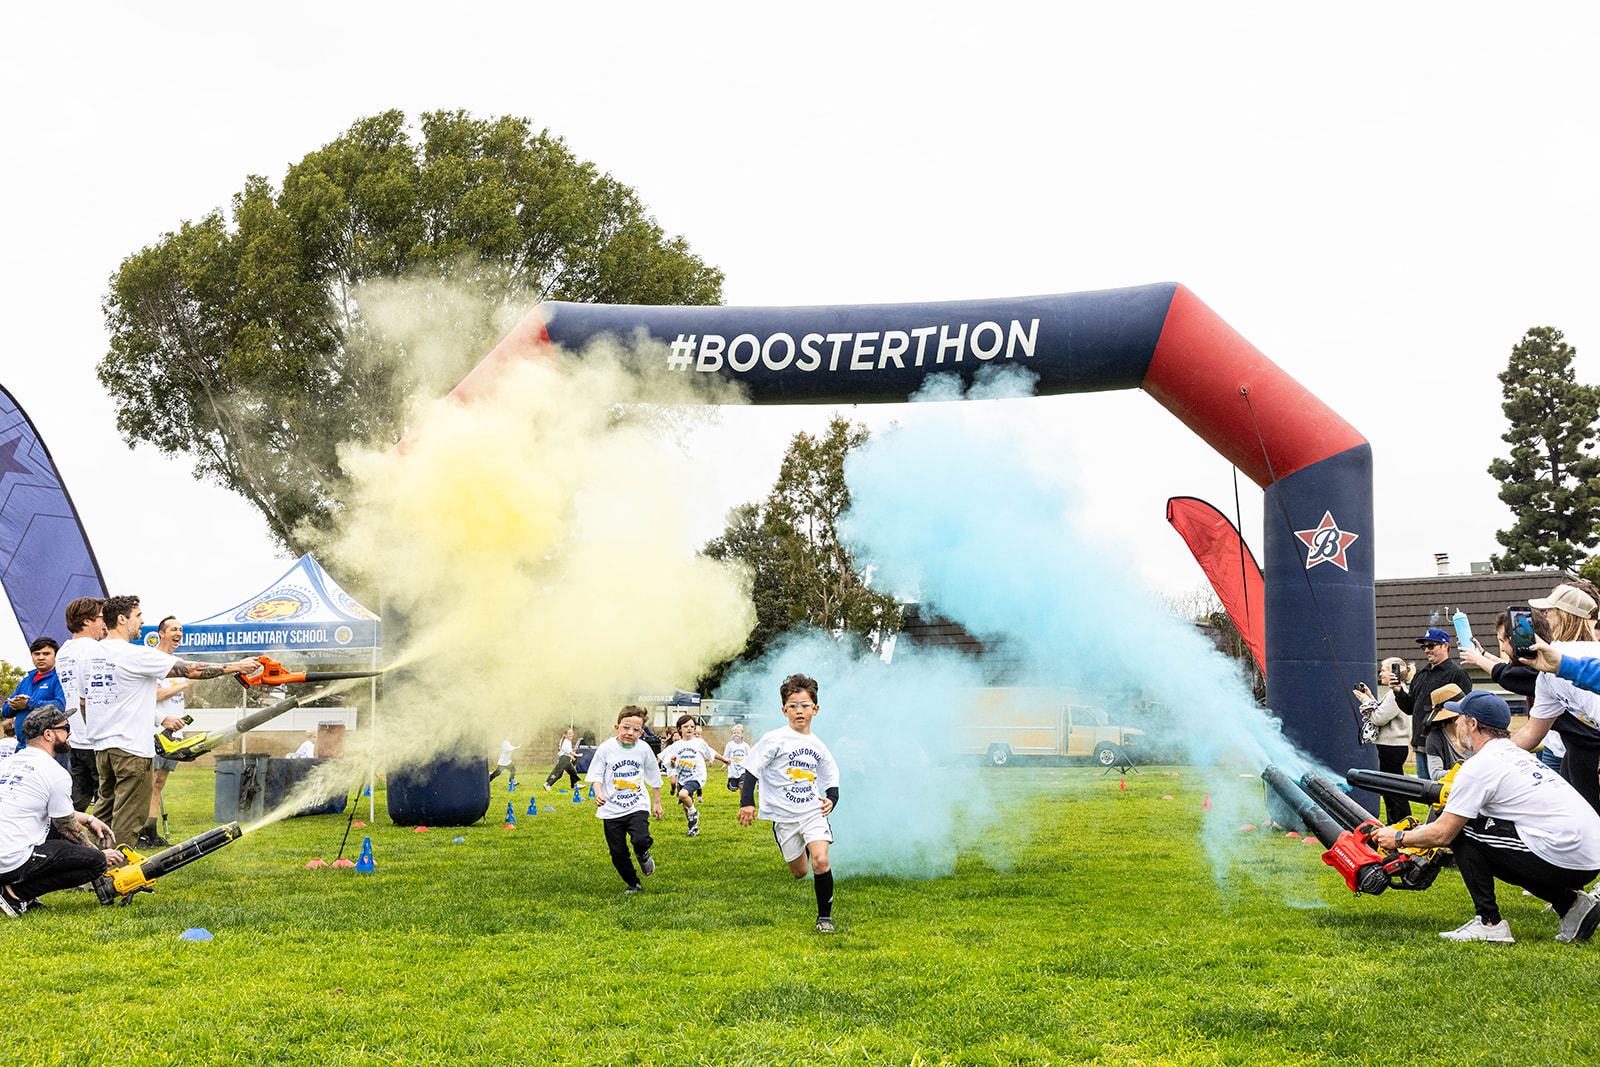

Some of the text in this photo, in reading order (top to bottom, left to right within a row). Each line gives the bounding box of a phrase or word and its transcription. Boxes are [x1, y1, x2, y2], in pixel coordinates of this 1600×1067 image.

[667, 318, 1040, 373] #BOOSTERTHON
[178, 629, 328, 647] LIFORNIA ELEMENTARY SCHOOL
[788, 748, 821, 763] CALIFORNIA
[785, 791, 805, 804] COLOR
[791, 785, 813, 794] COUGAR
[1334, 846, 1356, 869] CRAFTSMAN
